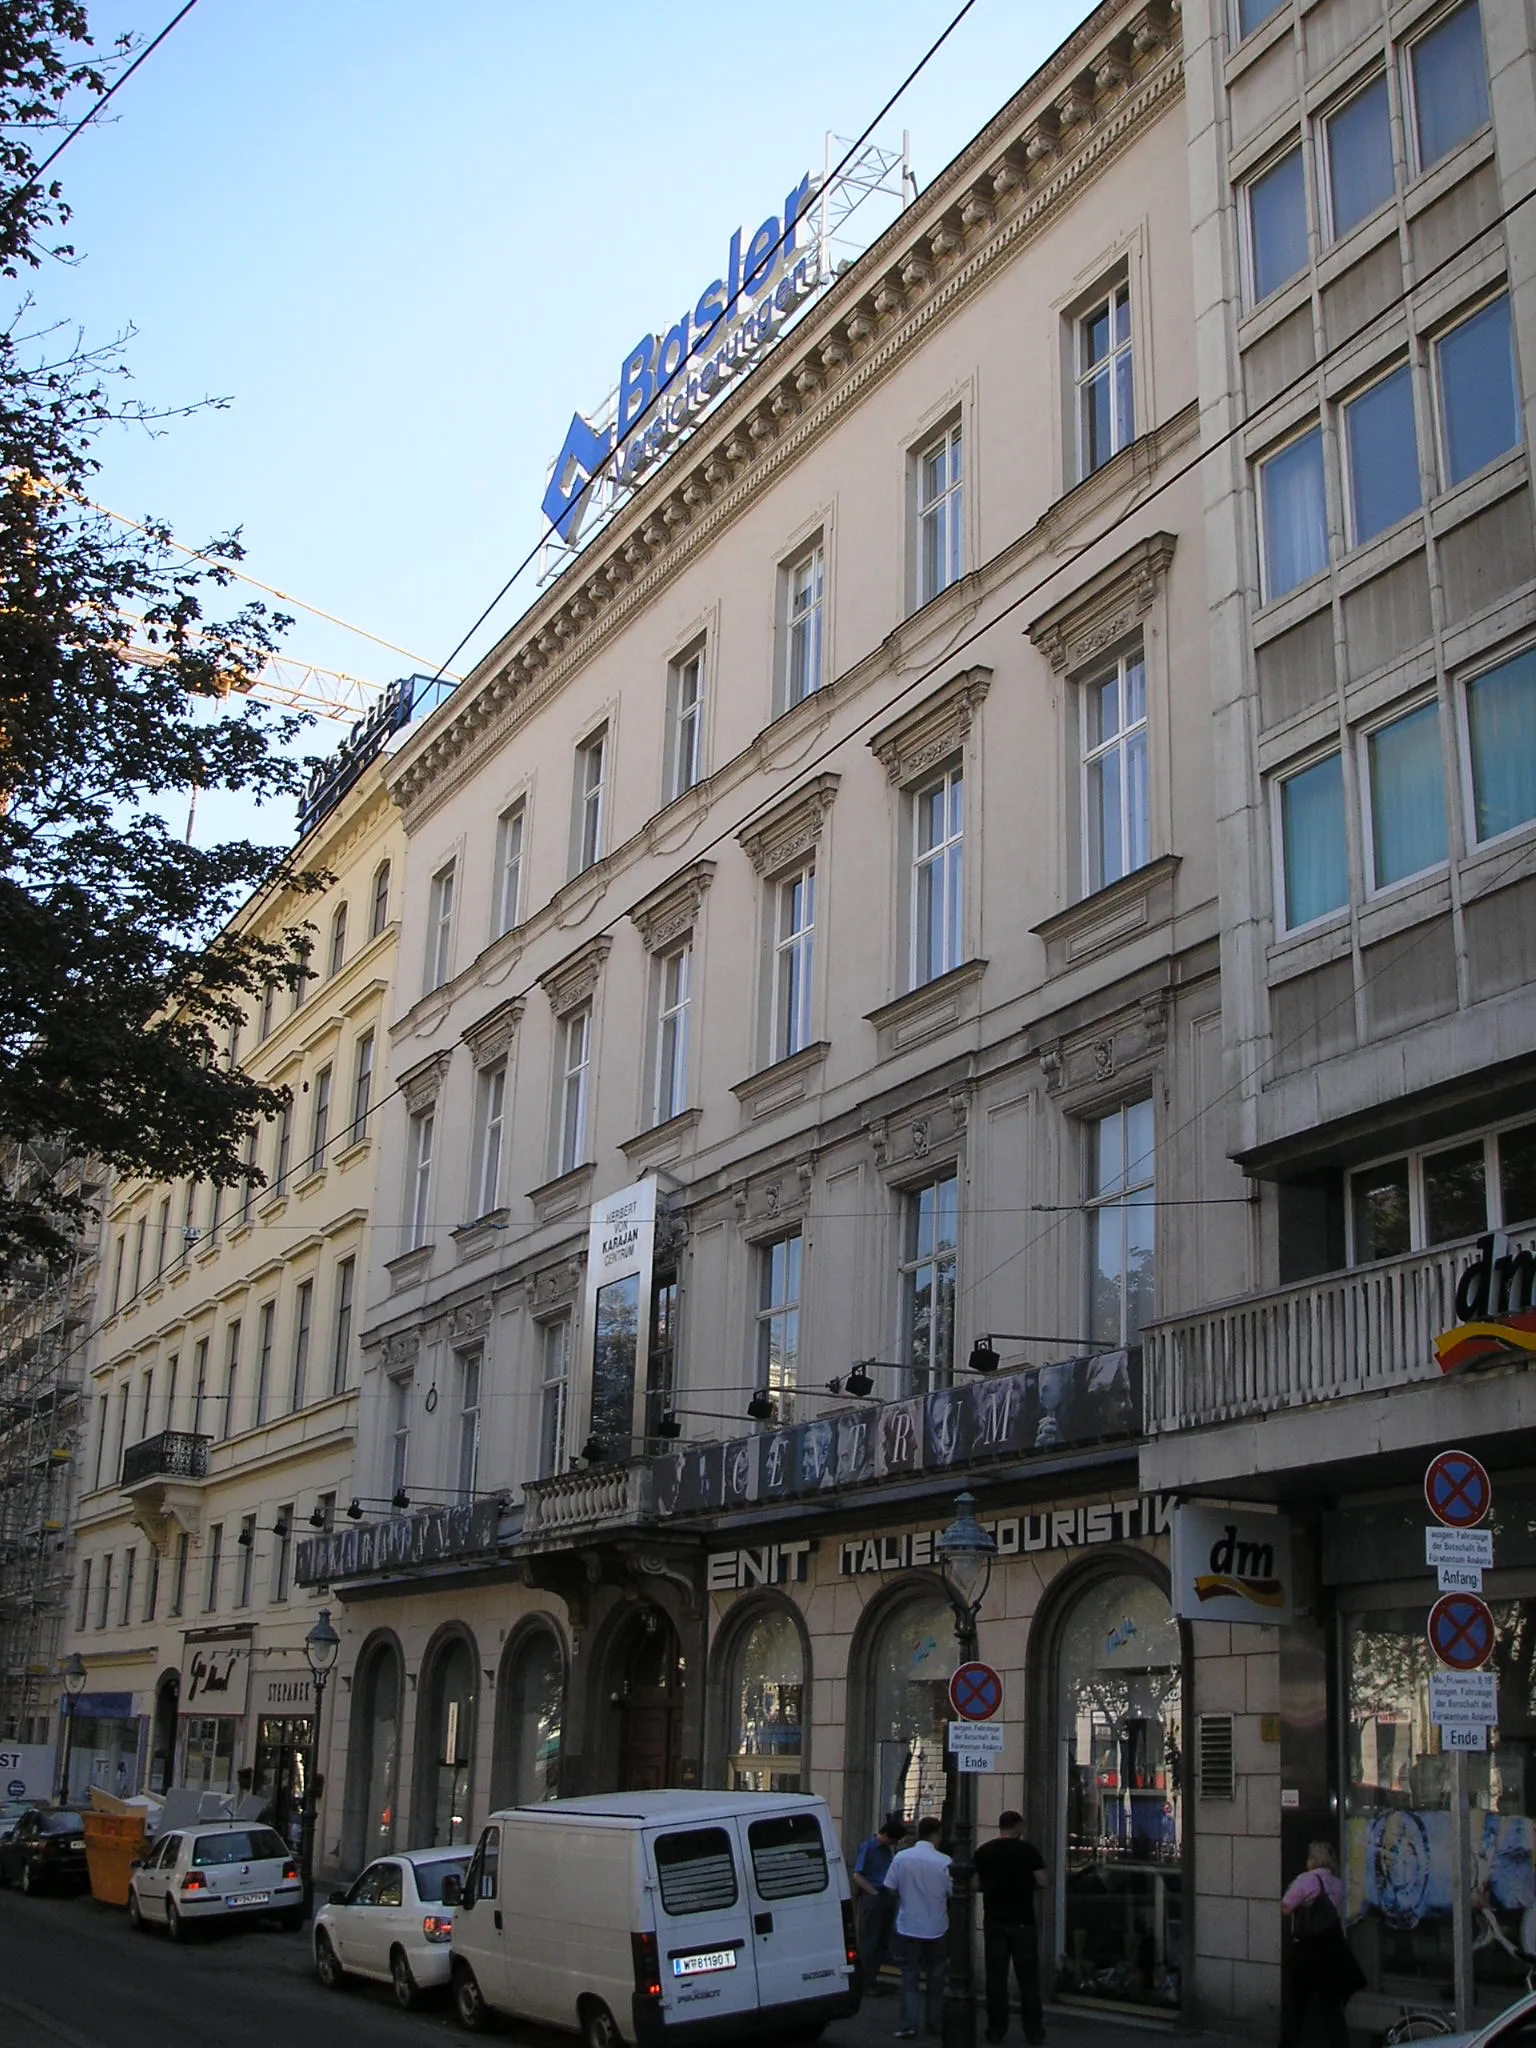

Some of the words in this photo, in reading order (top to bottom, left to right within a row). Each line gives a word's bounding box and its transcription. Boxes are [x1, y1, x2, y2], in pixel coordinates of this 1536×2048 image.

[617, 169, 812, 436] Basler
[606, 1201, 638, 1225] HERBERT
[614, 1219, 629, 1234] VON
[602, 1227, 639, 1255] KARAJAN
[604, 1244, 635, 1267] CENTRUM
[732, 1389, 1013, 1495] CENTRUM
[1210, 1525, 1276, 1578] dm
[706, 1540, 811, 1591] ENIT
[1443, 1569, 1477, 1589] Anfang
[1450, 1730, 1479, 1745] Ende
[965, 1756, 988, 1769] Ende
